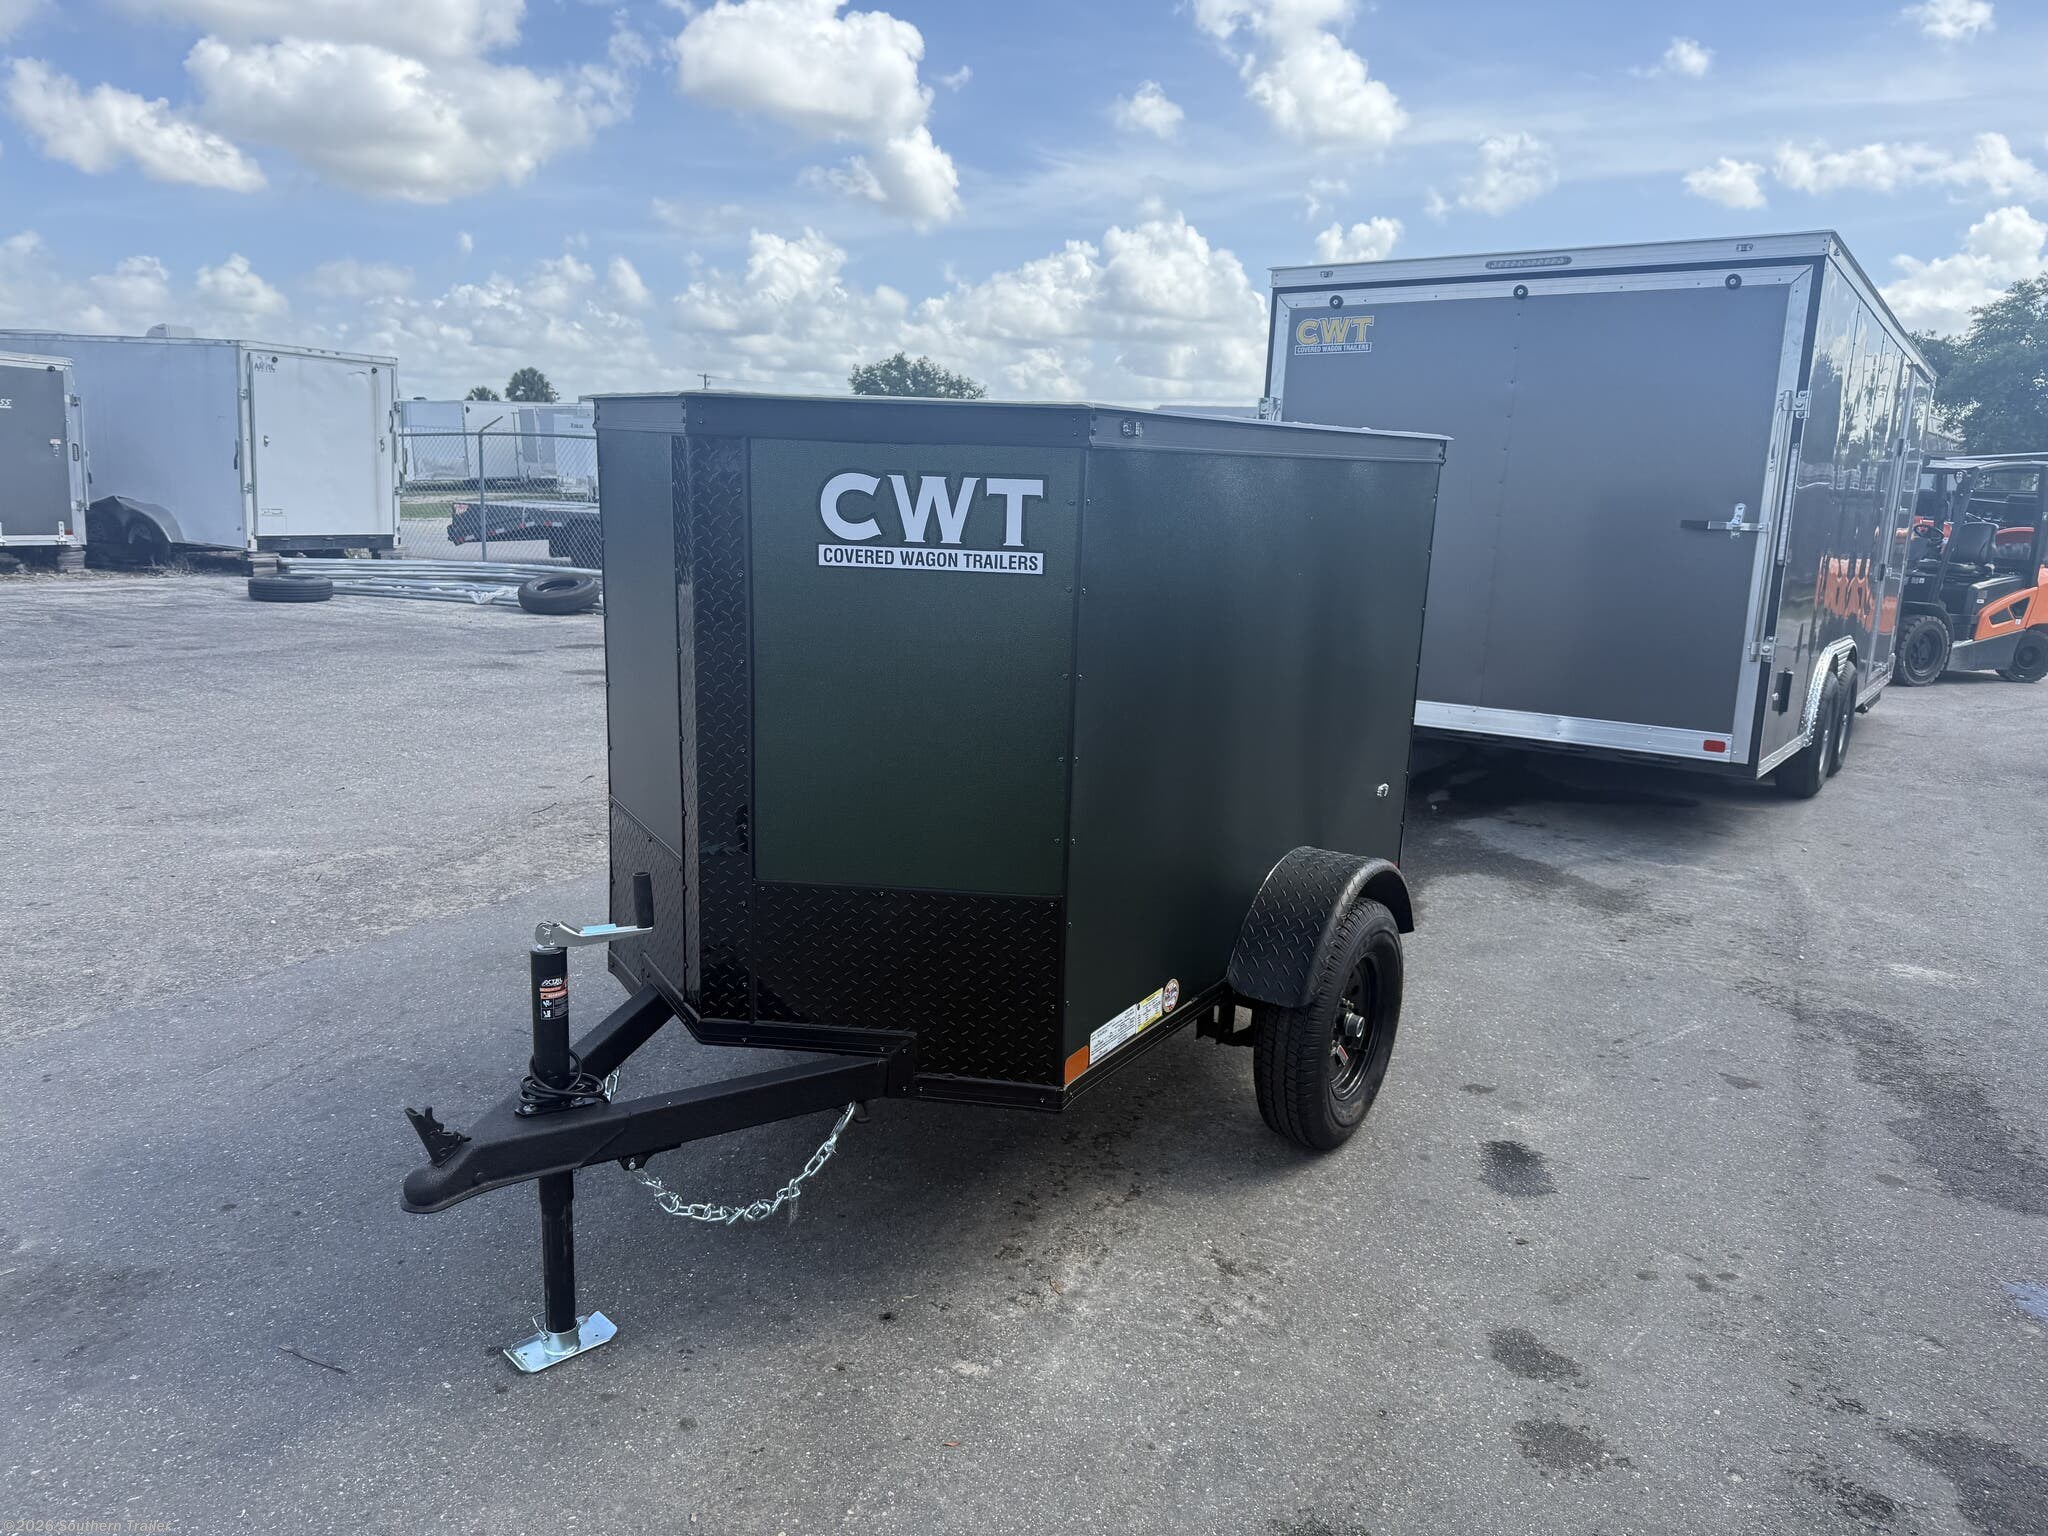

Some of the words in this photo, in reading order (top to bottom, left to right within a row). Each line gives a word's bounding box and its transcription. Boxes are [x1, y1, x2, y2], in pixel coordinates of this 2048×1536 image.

[1297, 316, 1374, 345] CWT
[1322, 345, 1342, 353] WAGON
[820, 472, 1044, 547] CWT
[823, 547, 895, 565] COVERED
[900, 550, 958, 568] WAGON
[963, 553, 1038, 571] TRAILERS
